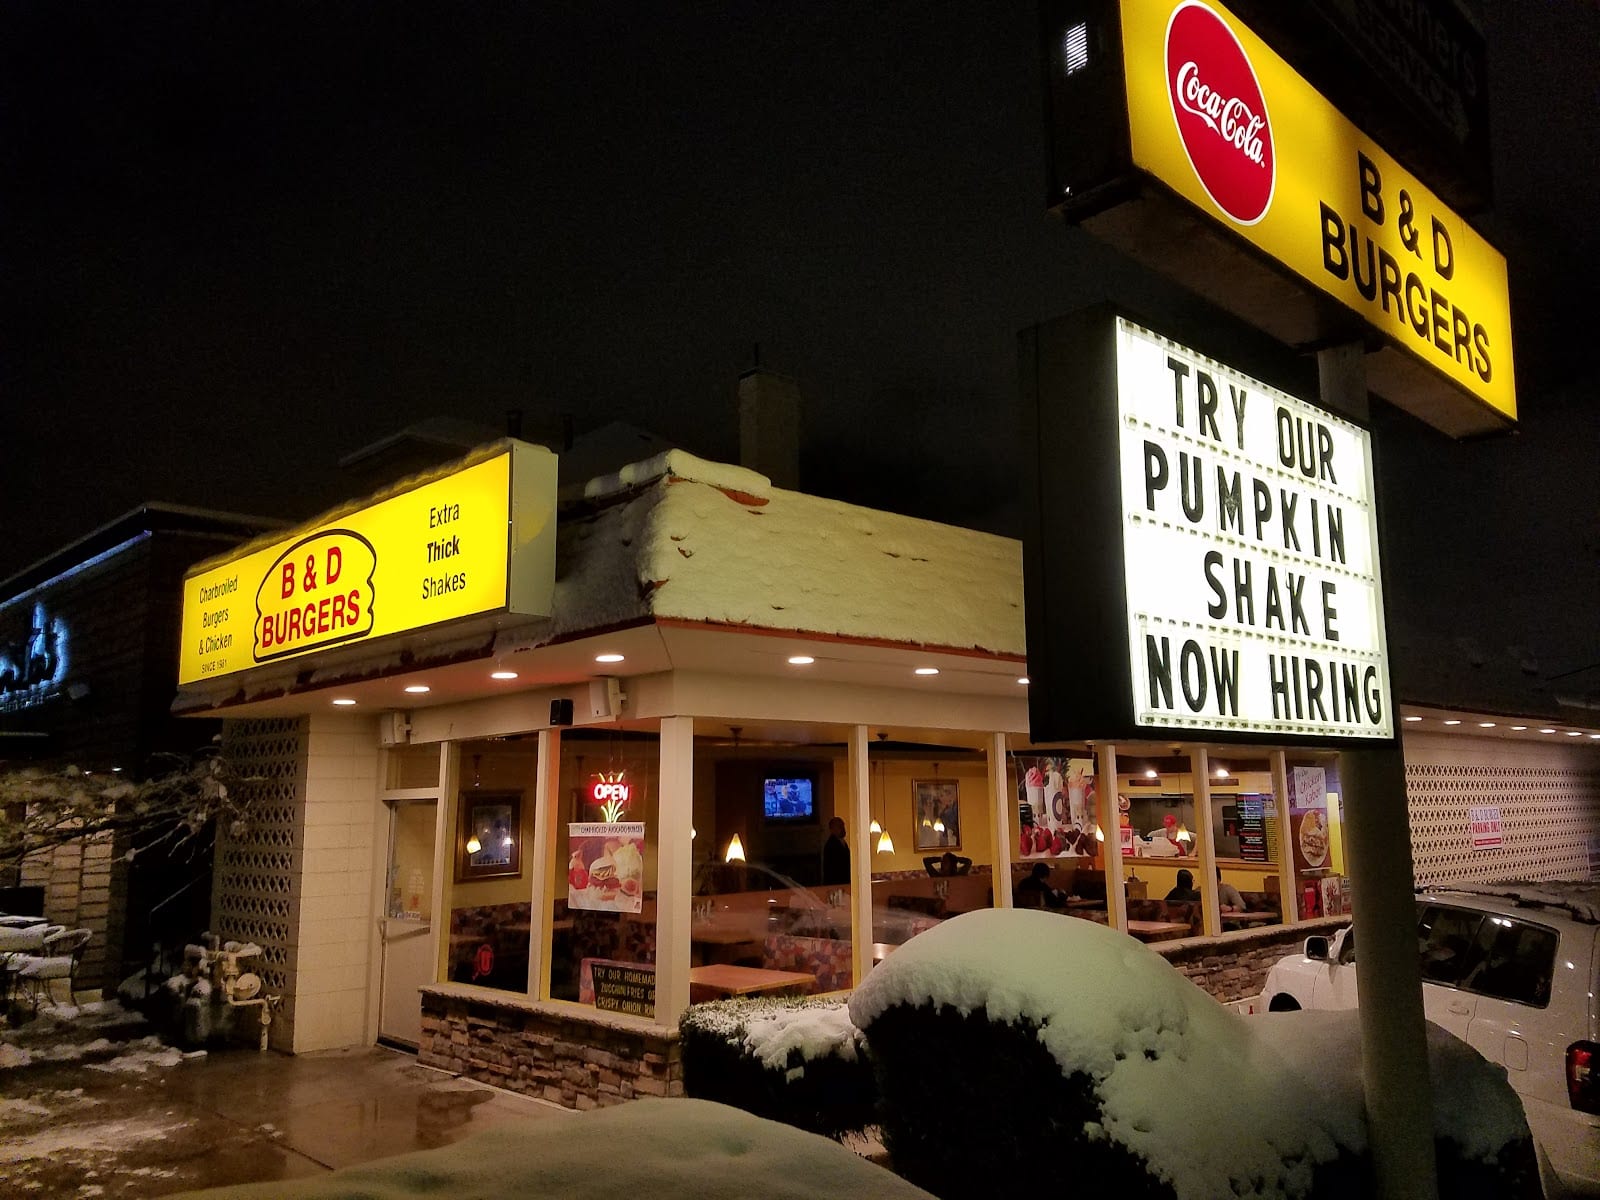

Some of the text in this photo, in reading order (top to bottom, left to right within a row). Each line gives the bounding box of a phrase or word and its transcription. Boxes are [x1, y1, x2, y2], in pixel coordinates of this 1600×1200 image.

[1176, 61, 1266, 167] Coca-Cola
[1357, 150, 1455, 282] B & D
[1319, 200, 1493, 384] BURGERS
[1167, 356, 1337, 484] TRY OUR
[429, 502, 460, 529] Extra
[1143, 439, 1346, 565] PUMPKIN
[427, 536, 460, 564] Thick
[199, 575, 238, 604] Charbroiled
[281, 546, 342, 599] B & D
[422, 572, 466, 600] Shakes
[1204, 550, 1340, 642] SHAKE
[203, 608, 229, 629] Burgers
[262, 589, 360, 649] BURGERS
[198, 633, 233, 655] & Chicken
[1146, 633, 1382, 725] NOW HIRING
[593, 783, 629, 801] OPEN
[593, 967, 656, 985] TRY OUR HOMEMAD
[597, 996, 619, 1009] CRISPY
[622, 1000, 641, 1013] ONION
